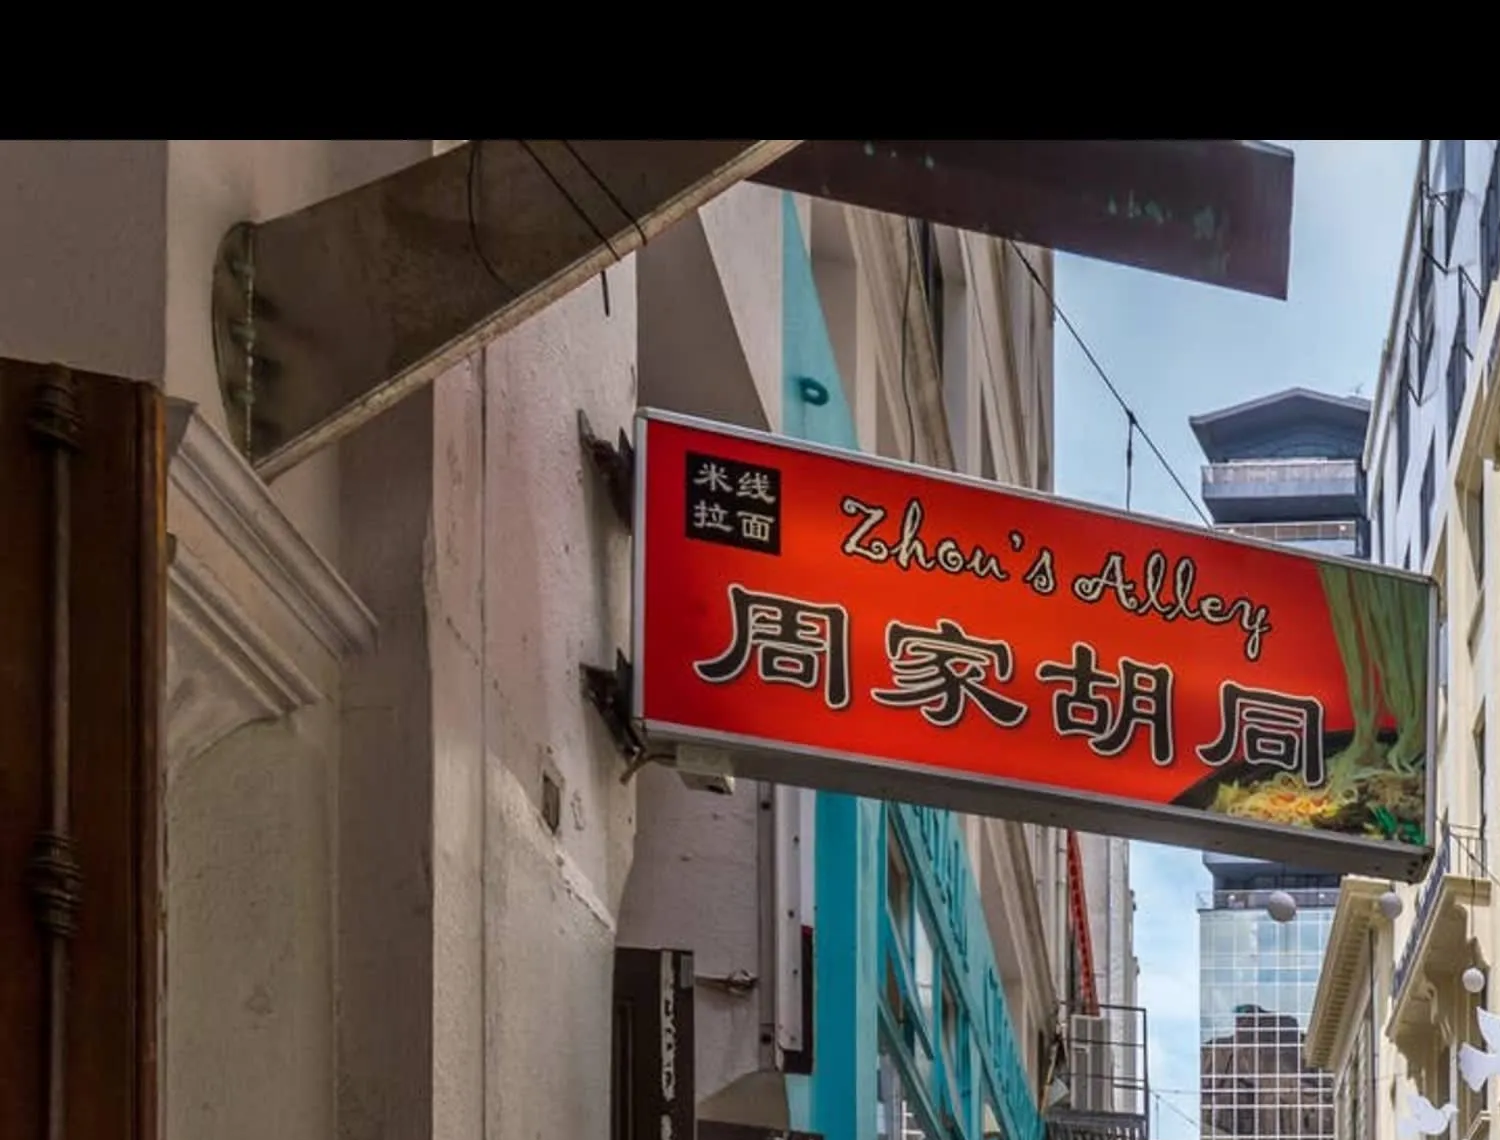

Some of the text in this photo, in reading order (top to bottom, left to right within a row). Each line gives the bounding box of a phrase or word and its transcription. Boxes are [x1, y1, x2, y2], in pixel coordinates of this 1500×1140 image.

[692, 462, 776, 504] 米线
[692, 500, 776, 542] 拉面
[840, 496, 1272, 661] Zhou's Alley
[693, 582, 1327, 788] 周家胡同
